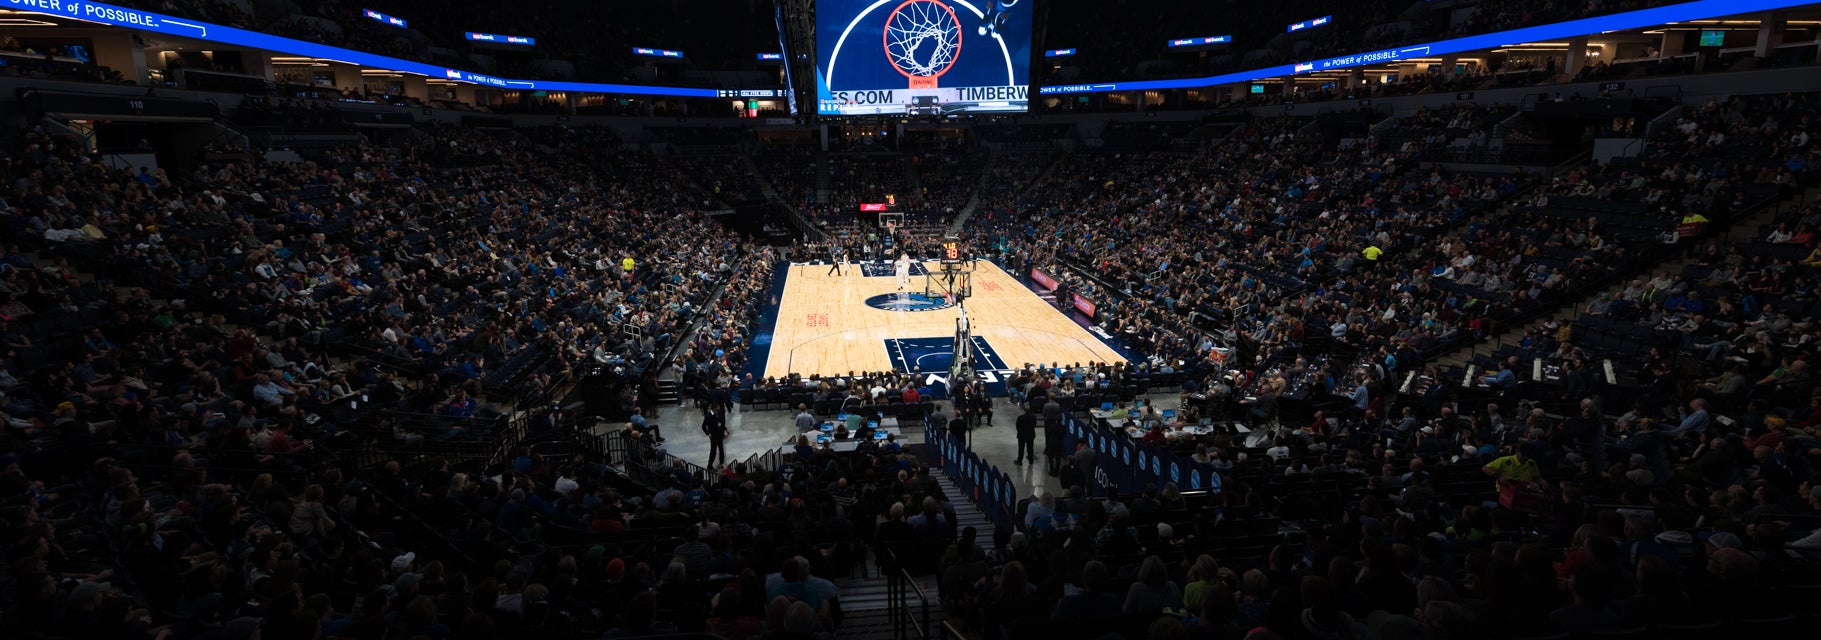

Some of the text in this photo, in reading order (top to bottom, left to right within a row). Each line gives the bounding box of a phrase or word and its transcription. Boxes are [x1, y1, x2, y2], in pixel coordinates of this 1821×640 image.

[67, 2, 79, 15] of
[1332, 57, 1354, 66] POWER
[1356, 55, 1362, 64] of
[956, 86, 1029, 101] TIMBERW
[130, 101, 144, 110] 110
